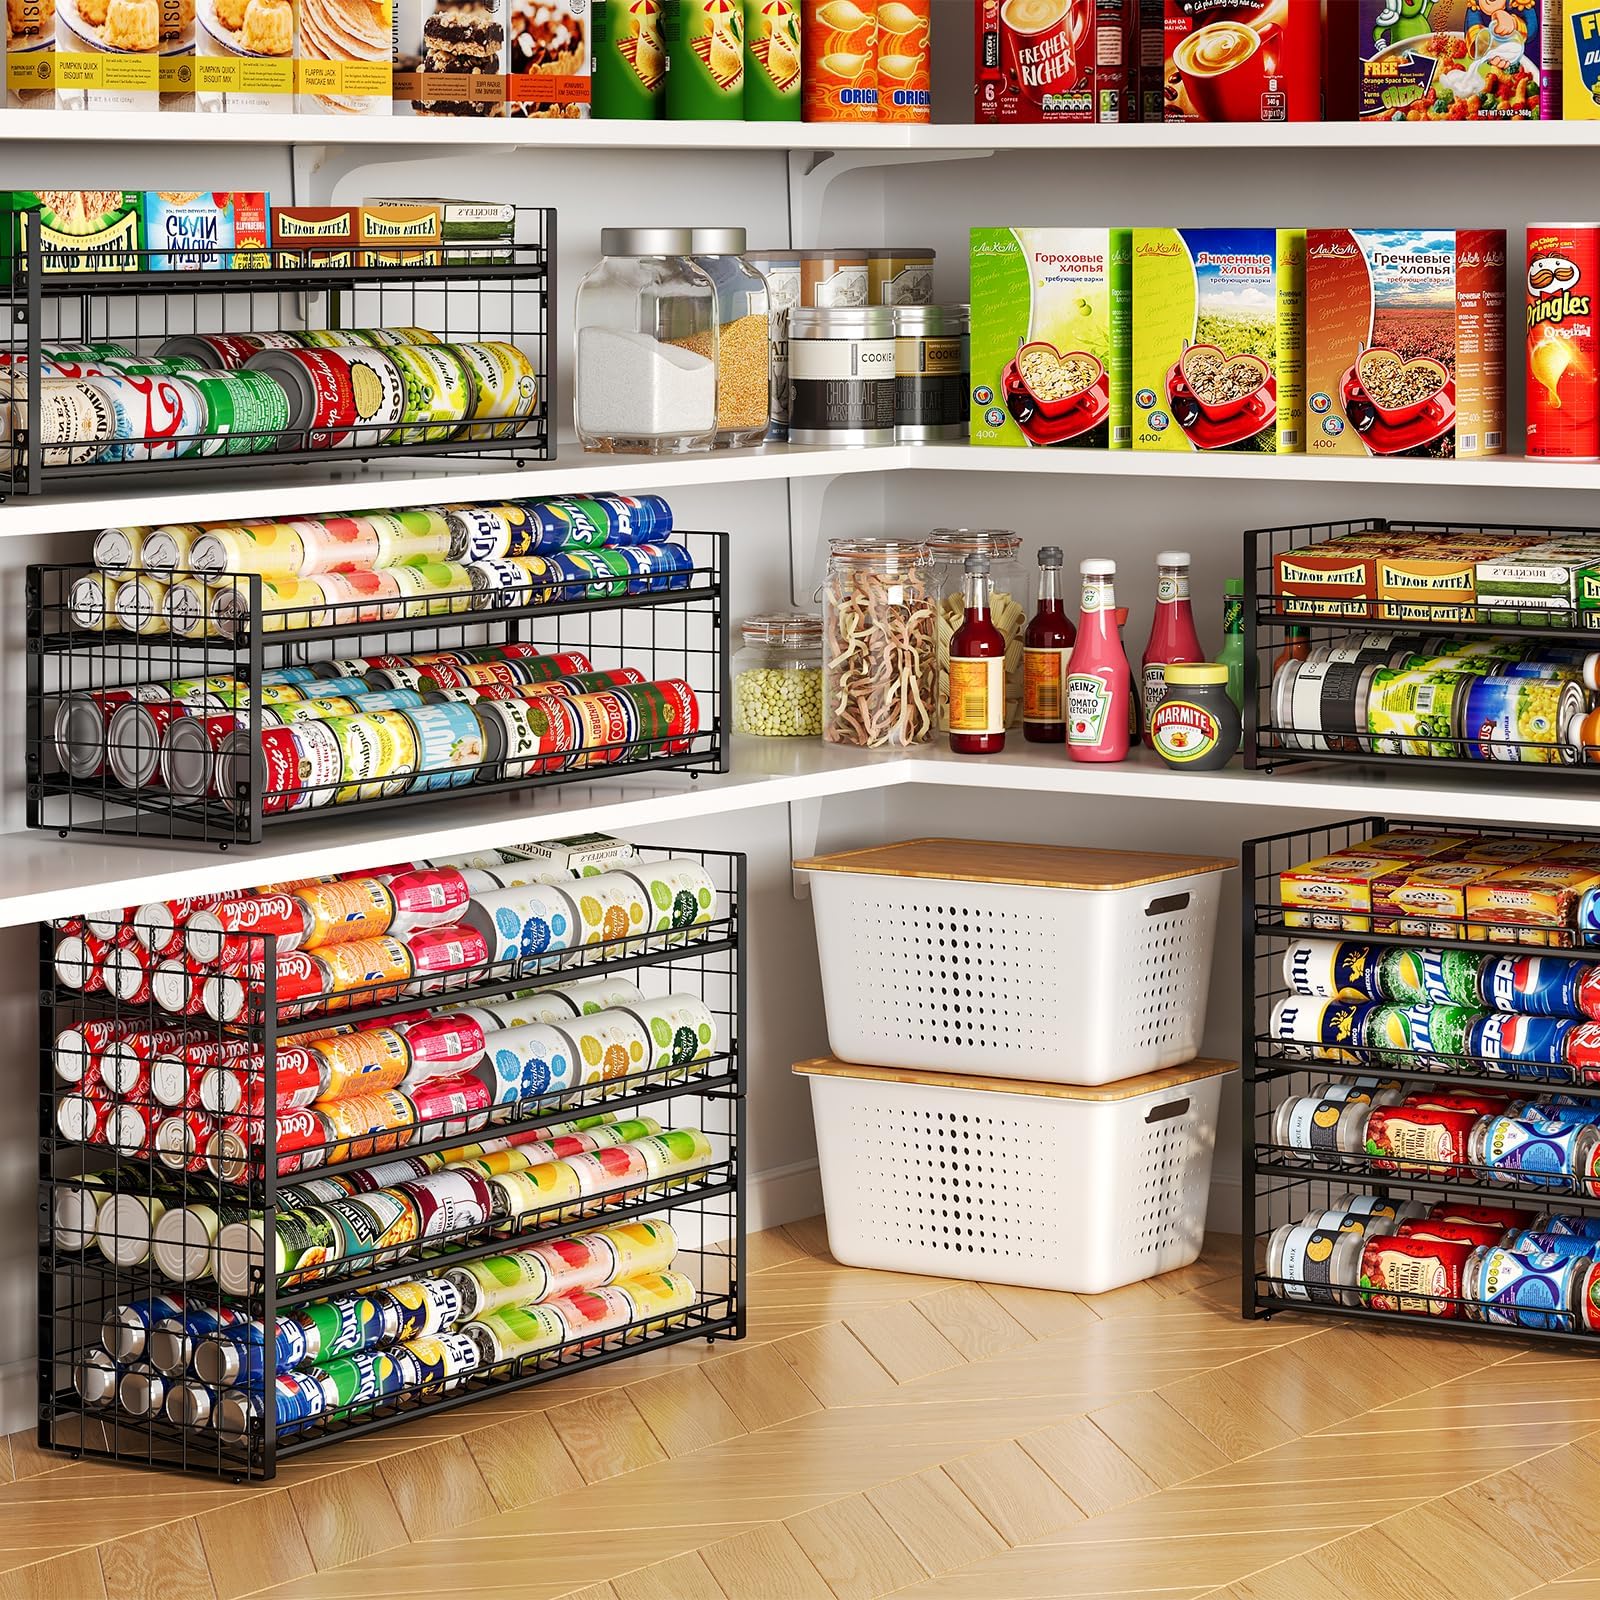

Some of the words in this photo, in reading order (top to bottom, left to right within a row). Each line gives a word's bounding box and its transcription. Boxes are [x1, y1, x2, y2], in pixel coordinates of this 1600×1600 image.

[1019, 31, 1070, 63] FRESHER
[1022, 51, 1076, 87] RICHER
[1364, 62, 1398, 75] FREE
[985, 84, 995, 101] 6
[1381, 85, 1425, 108] GREEN
[1035, 252, 1103, 265] Гороховые
[1198, 252, 1271, 266] Ячменные
[1374, 252, 1451, 265] Гречневые
[1059, 263, 1103, 273] хлопья
[1220, 265, 1271, 275] хлопья
[1400, 265, 1451, 275] хлопья
[1527, 291, 1590, 329] Pringles
[1544, 326, 1590, 339] Original
[384, 366, 401, 422] SOUP
[976, 430, 999, 439] 400г
[1139, 434, 1161, 443] 400г
[1070, 681, 1096, 694] HEINZ
[1157, 706, 1208, 728] MARMITE
[332, 1202, 372, 1243] HEINZ
